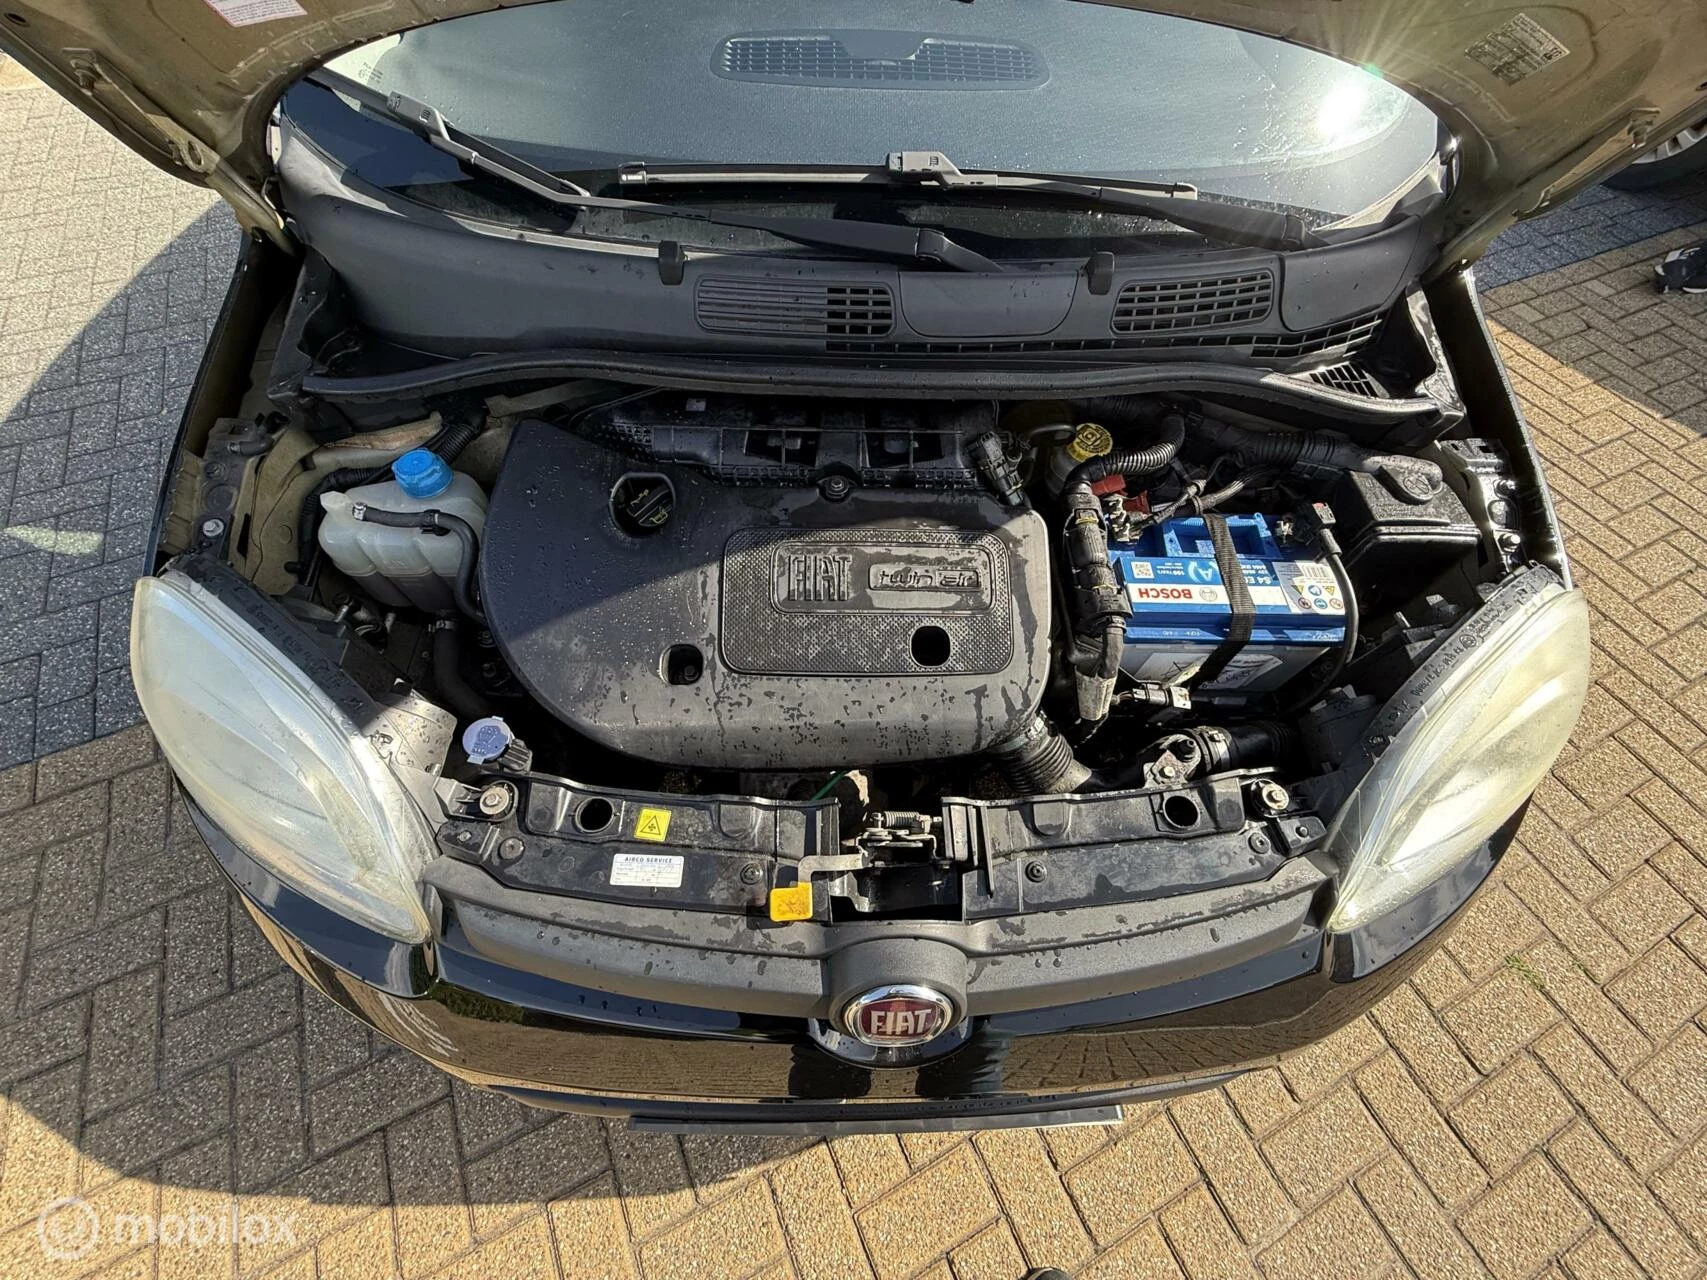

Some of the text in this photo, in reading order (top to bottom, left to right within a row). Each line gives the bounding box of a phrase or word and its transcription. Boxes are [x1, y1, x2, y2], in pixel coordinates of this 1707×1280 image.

[788, 554, 852, 601] FIAT
[1138, 587, 1193, 599] BOSCH
[646, 856, 673, 864] SERVICE
[871, 1009, 932, 1035] FIAT
